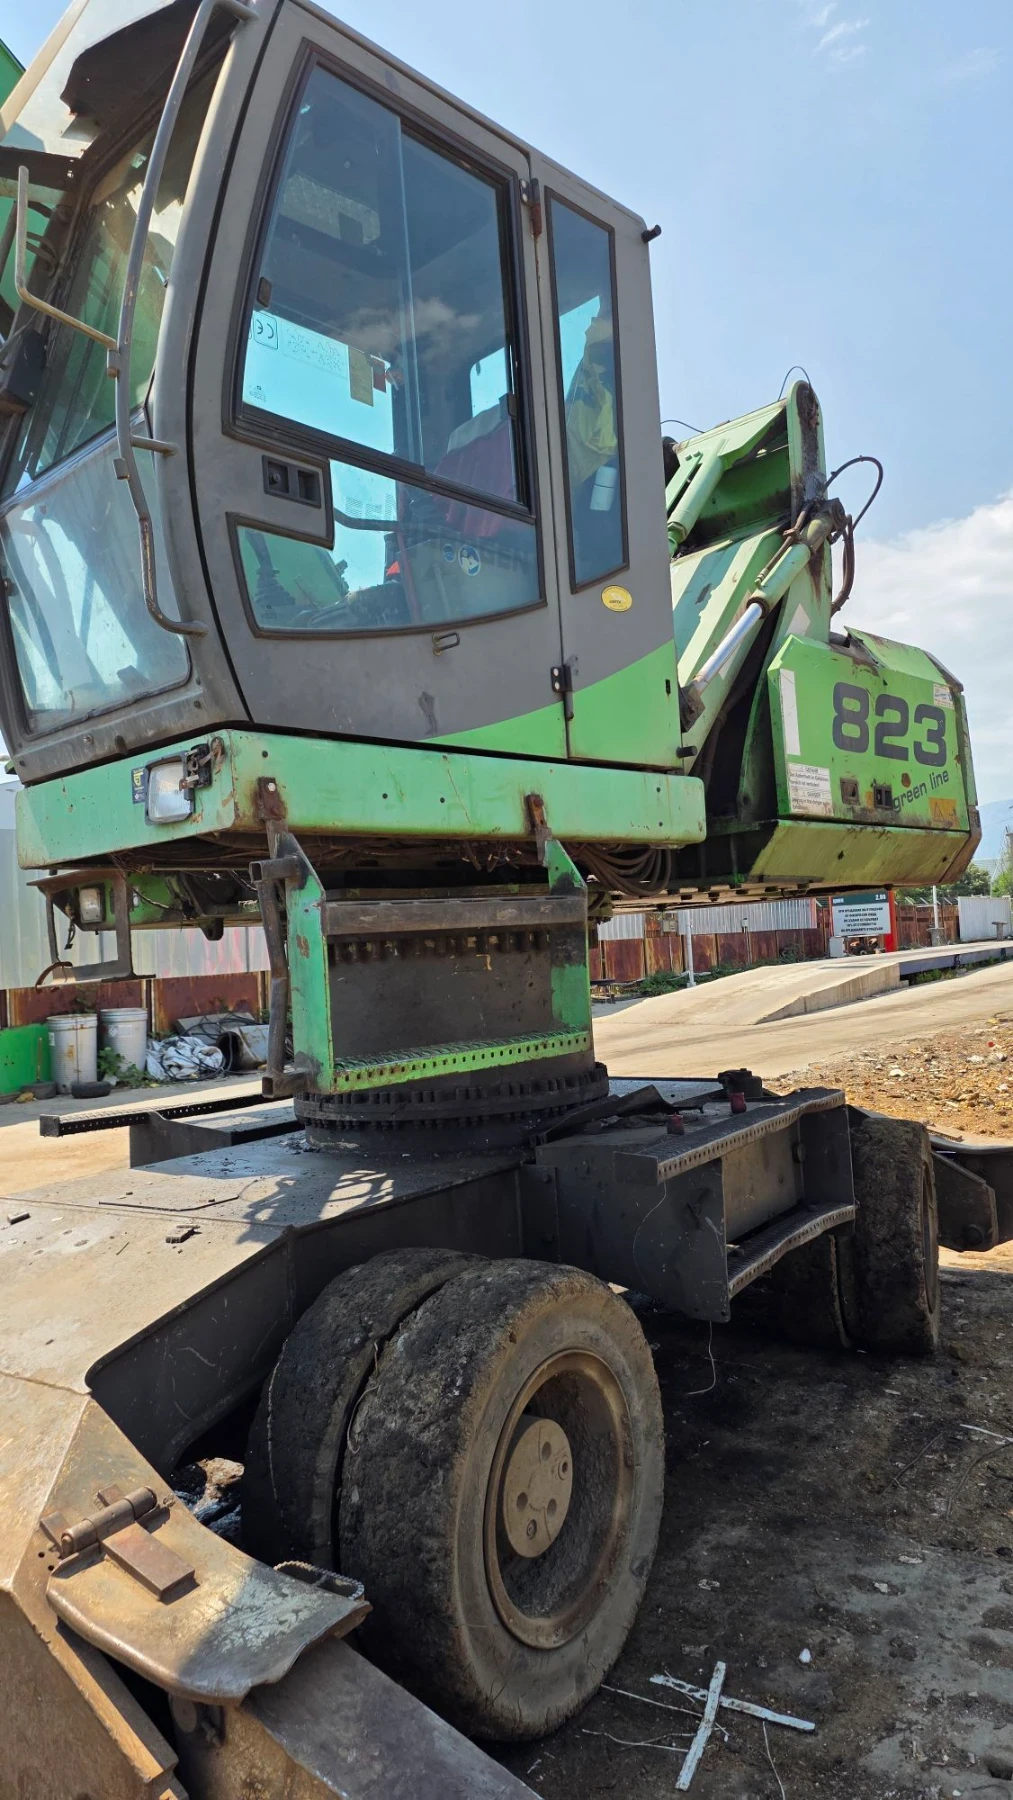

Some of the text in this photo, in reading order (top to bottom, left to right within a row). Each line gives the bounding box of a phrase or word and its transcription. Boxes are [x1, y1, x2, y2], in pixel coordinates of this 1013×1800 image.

[832, 681, 947, 768] 823
[892, 769, 950, 813] green line
